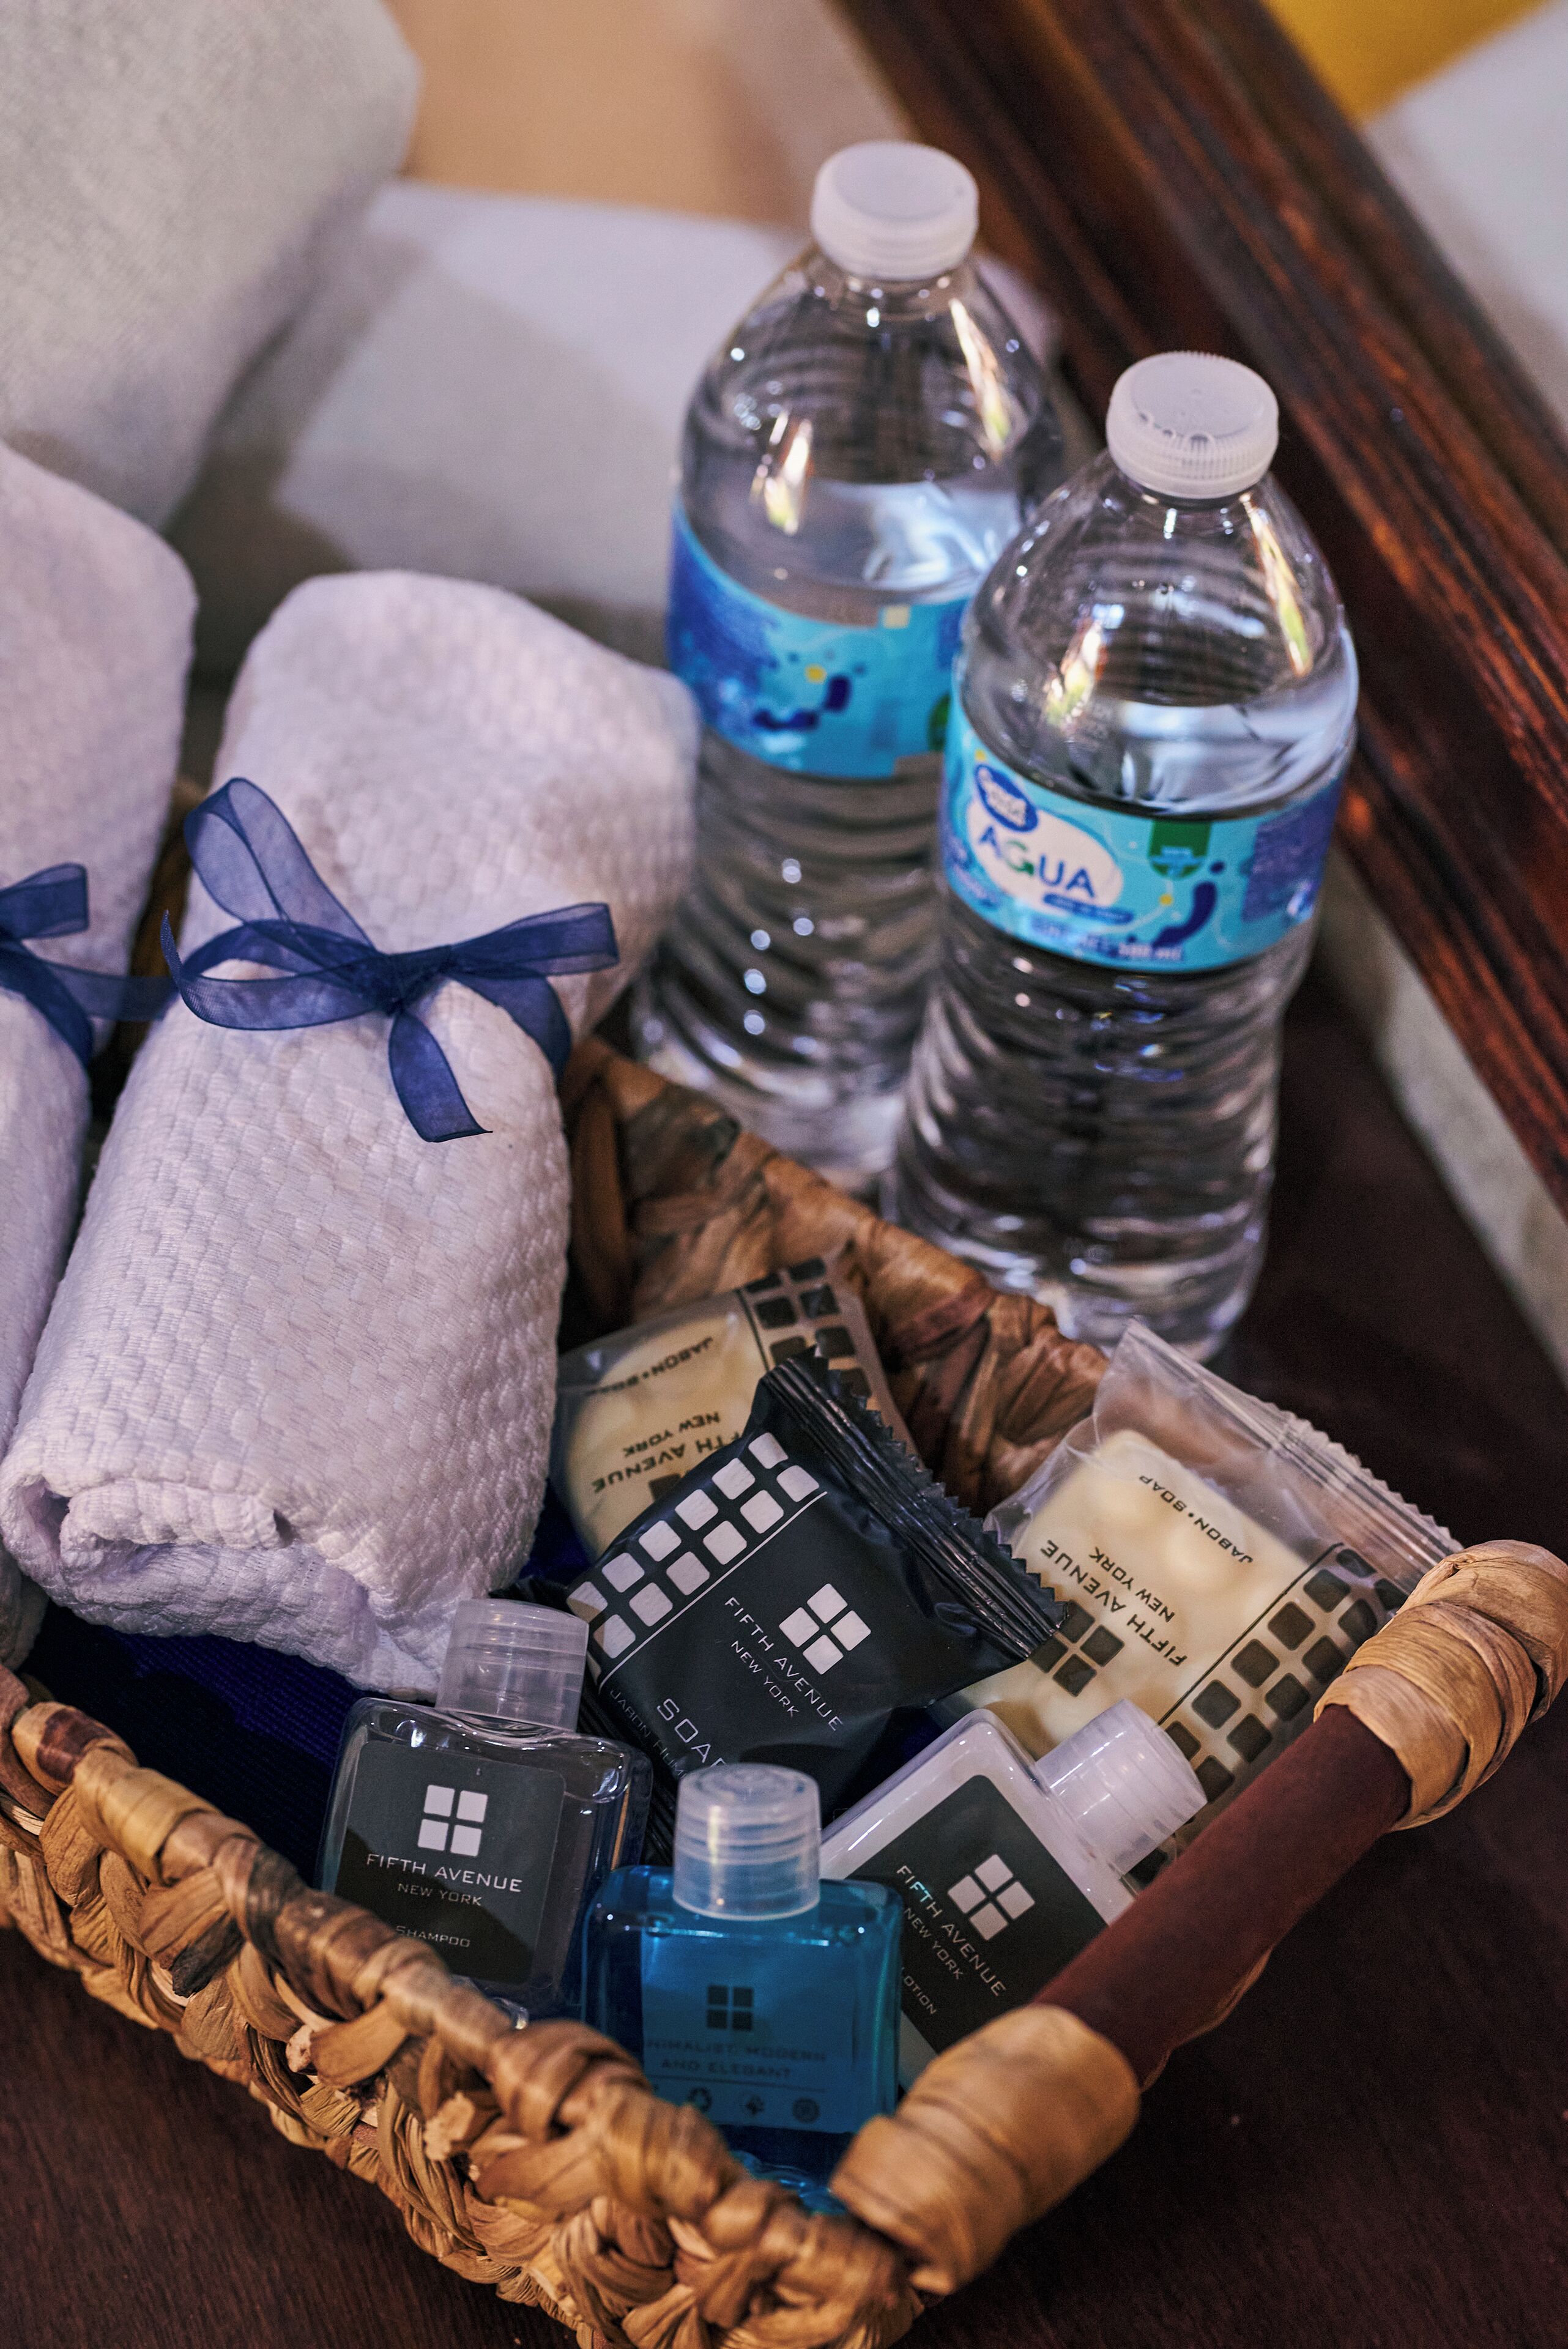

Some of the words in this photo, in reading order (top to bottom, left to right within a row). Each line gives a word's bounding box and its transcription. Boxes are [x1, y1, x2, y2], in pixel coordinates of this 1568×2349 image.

[979, 826, 1095, 899] AGUA
[622, 1429, 674, 1458] YORK
[678, 1411, 721, 1432] NEW
[591, 1442, 686, 1494] AVENUE
[1139, 1475, 1187, 1512] SOAP
[1194, 1517, 1254, 1563] JABON
[1040, 1539, 1127, 1612] AVENUE
[1088, 1546, 1134, 1591] YORK
[1135, 1588, 1175, 1623] NEW
[724, 1597, 775, 1651] FIFTH
[773, 1657, 844, 1731] AVENUE
[1126, 1614, 1188, 1668] FIFTH
[730, 1640, 762, 1674] NEW
[764, 1675, 800, 1718] YORK
[366, 1853, 426, 1876] FIFTH
[434, 1866, 523, 1893] AVENUE
[398, 1883, 433, 1897] NEW
[439, 1890, 483, 1907] YORK
[396, 1925, 471, 1948] SHAMPOO
[896, 1865, 943, 1918] FIFTH
[942, 1923, 1006, 1997] AVENUE
[904, 1907, 932, 1939] NEW
[933, 1941, 964, 1980] YORK
[901, 1967, 937, 2014] OTION
